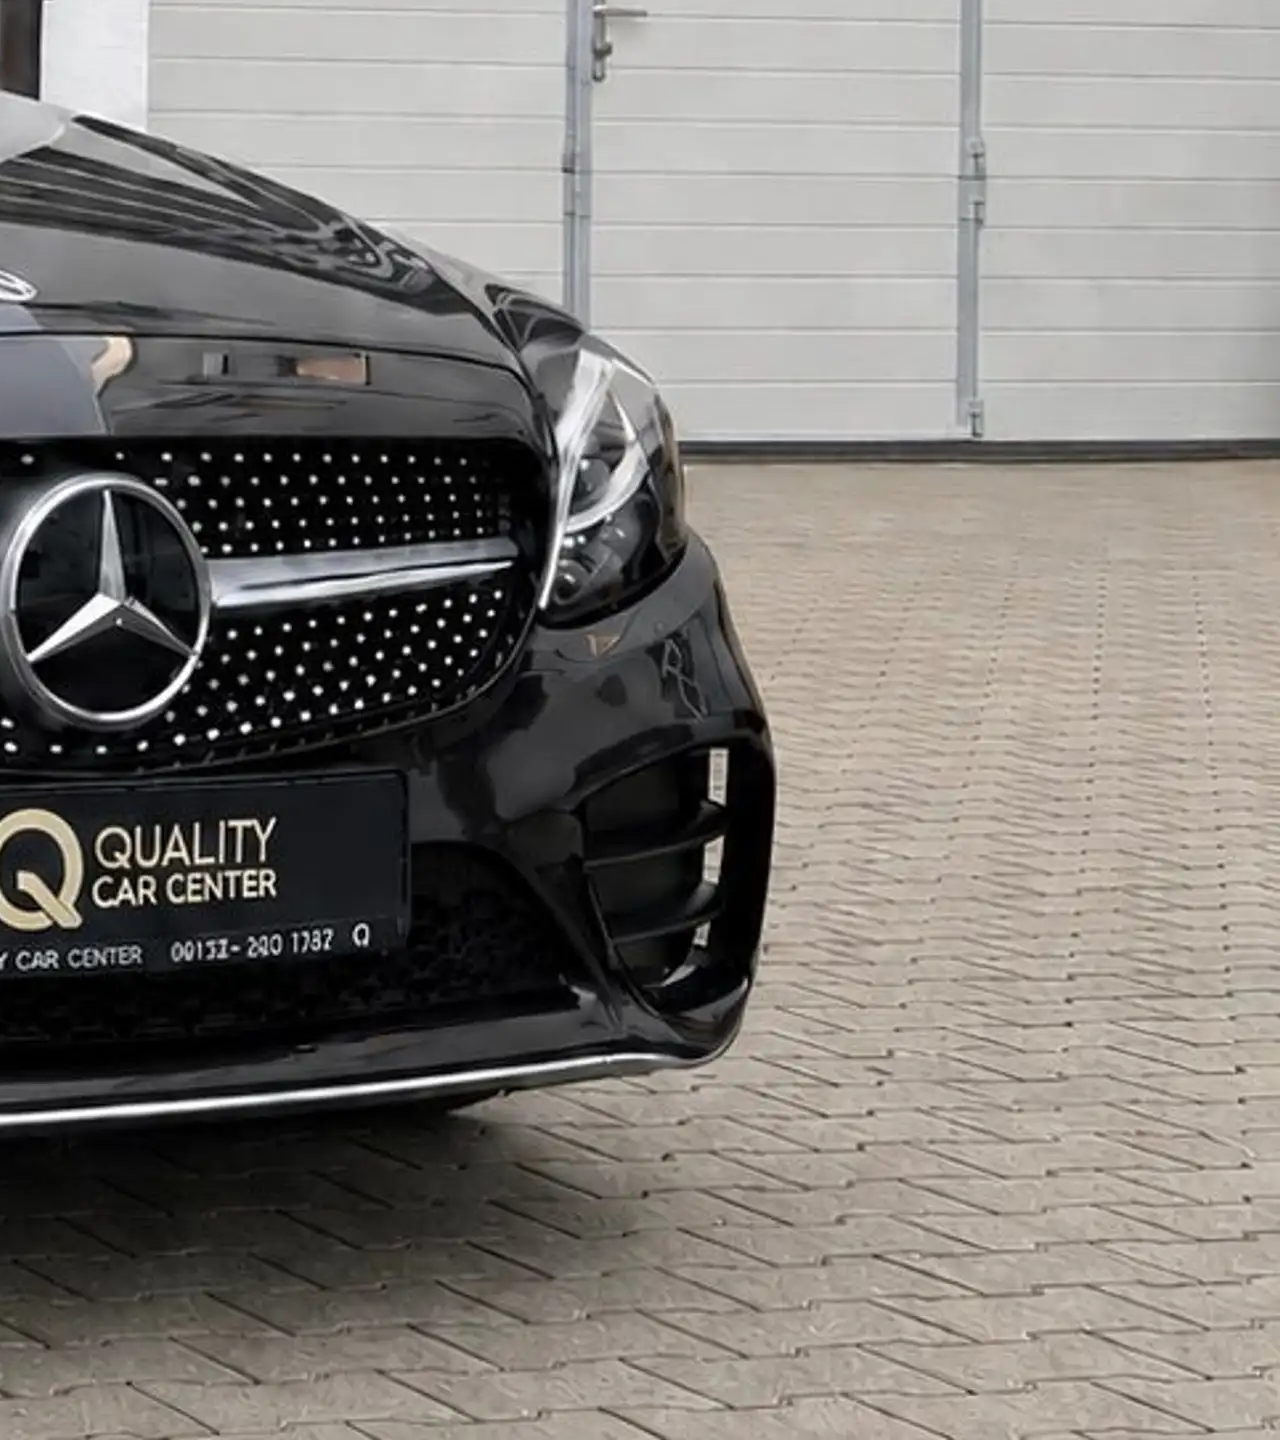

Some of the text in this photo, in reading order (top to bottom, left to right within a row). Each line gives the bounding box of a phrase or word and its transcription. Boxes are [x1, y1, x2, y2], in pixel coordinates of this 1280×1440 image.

[94, 816, 277, 869] QUALITY
[92, 868, 277, 909] CAR CENTER
[15, 950, 59, 971] CAR
[67, 945, 143, 968] CENTER
